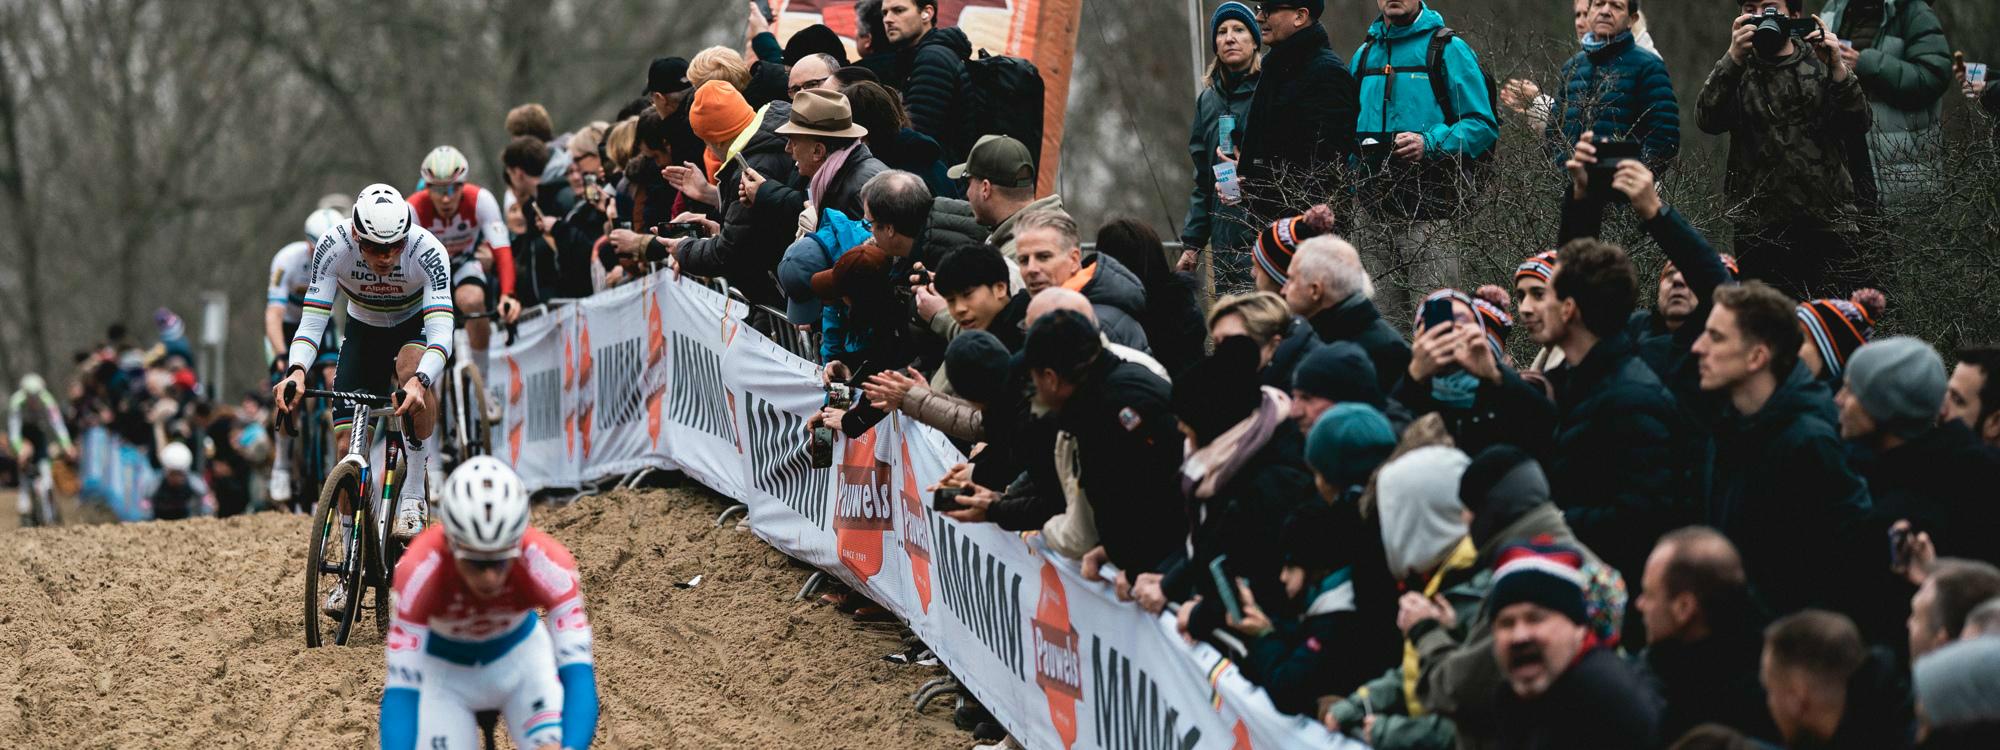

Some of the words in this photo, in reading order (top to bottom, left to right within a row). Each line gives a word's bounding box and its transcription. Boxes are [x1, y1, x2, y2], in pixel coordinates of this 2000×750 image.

[312, 235, 336, 284] deceuninck
[356, 271, 377, 282] UCI
[421, 247, 449, 290] Alpecin
[365, 285, 400, 293] Alpecin
[836, 470, 891, 520] Pauwels
[903, 498, 930, 553] Pauwels
[1035, 626, 1080, 688] Pauwels
